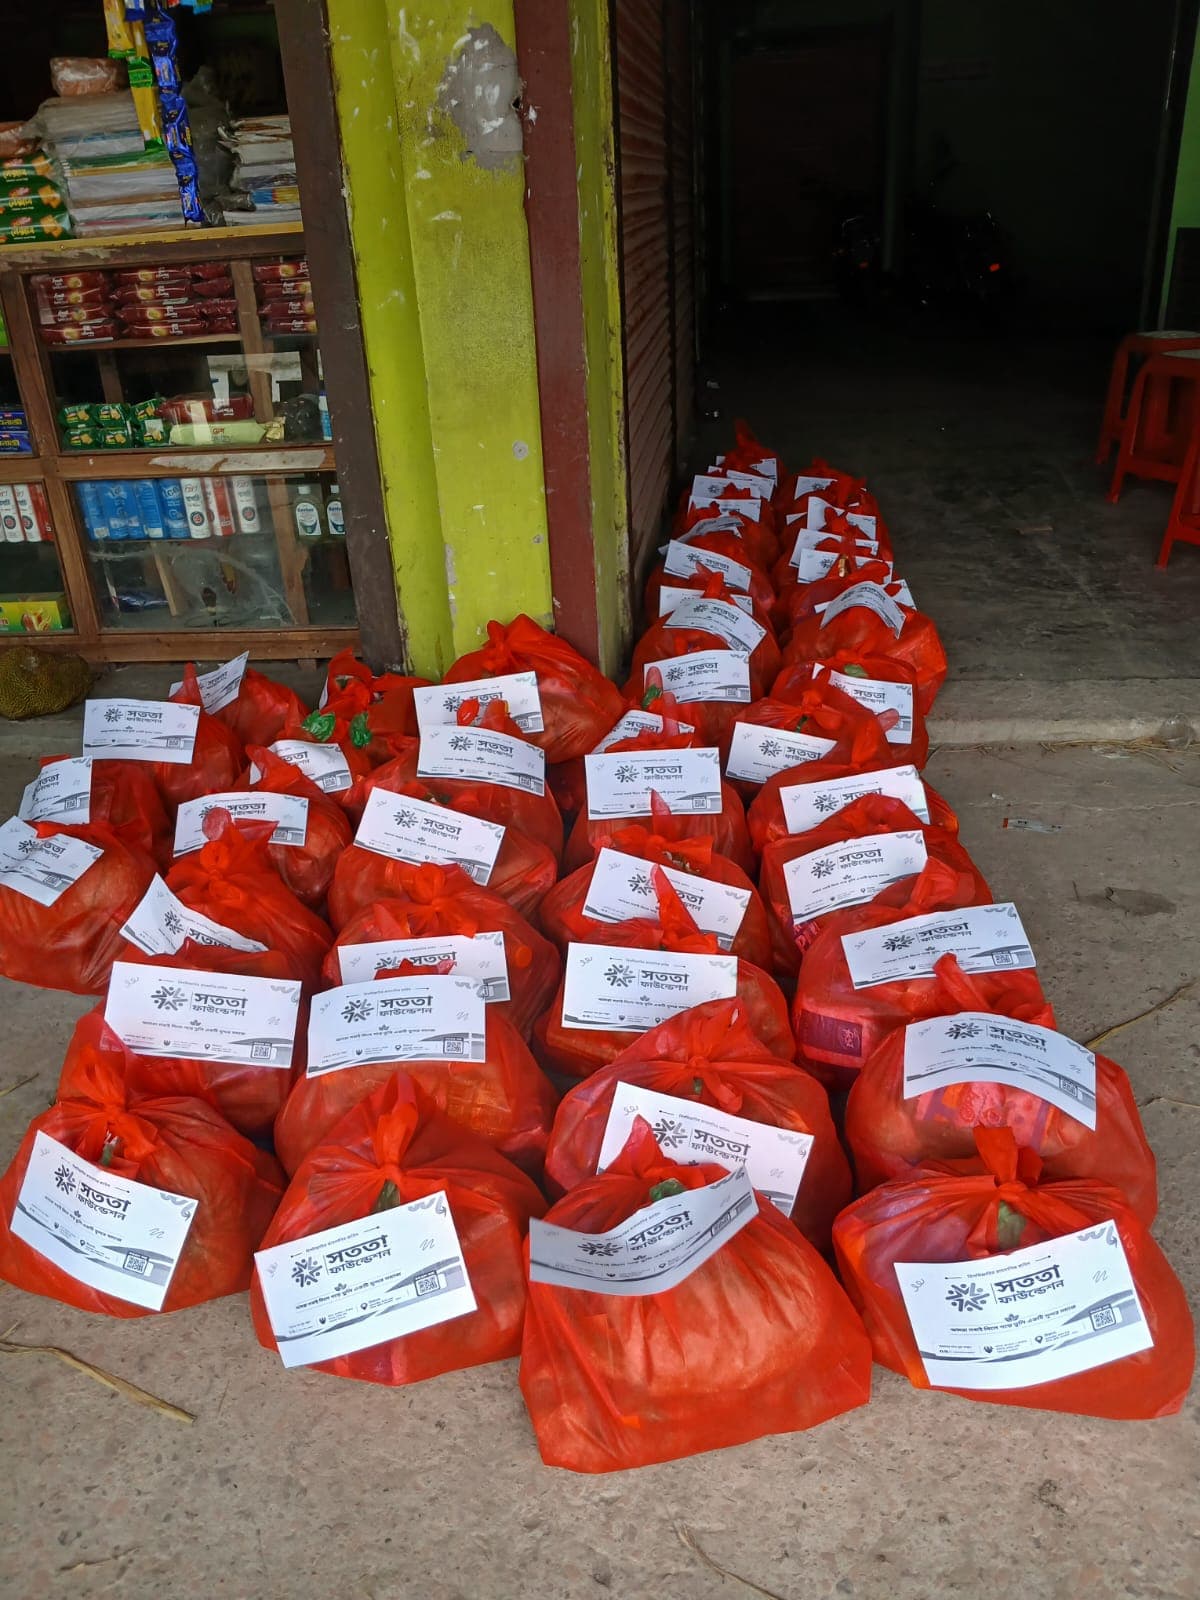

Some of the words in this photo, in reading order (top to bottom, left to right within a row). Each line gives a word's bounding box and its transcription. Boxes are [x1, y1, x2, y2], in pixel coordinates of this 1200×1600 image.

[643, 765, 683, 775] সততা
[422, 817, 462, 835] সততা
[838, 848, 883, 863] সততা
[917, 922, 970, 938] সততা
[640, 969, 690, 985] সততা
[193, 992, 249, 1009] সততা
[380, 995, 434, 1009] সততা
[988, 1025, 1048, 1047] সততা
[693, 1127, 752, 1156] সততা
[78, 1181, 132, 1213] সততা
[627, 1209, 691, 1246] সততা
[326, 1234, 389, 1266] সততা
[994, 1264, 1060, 1293] সততা
